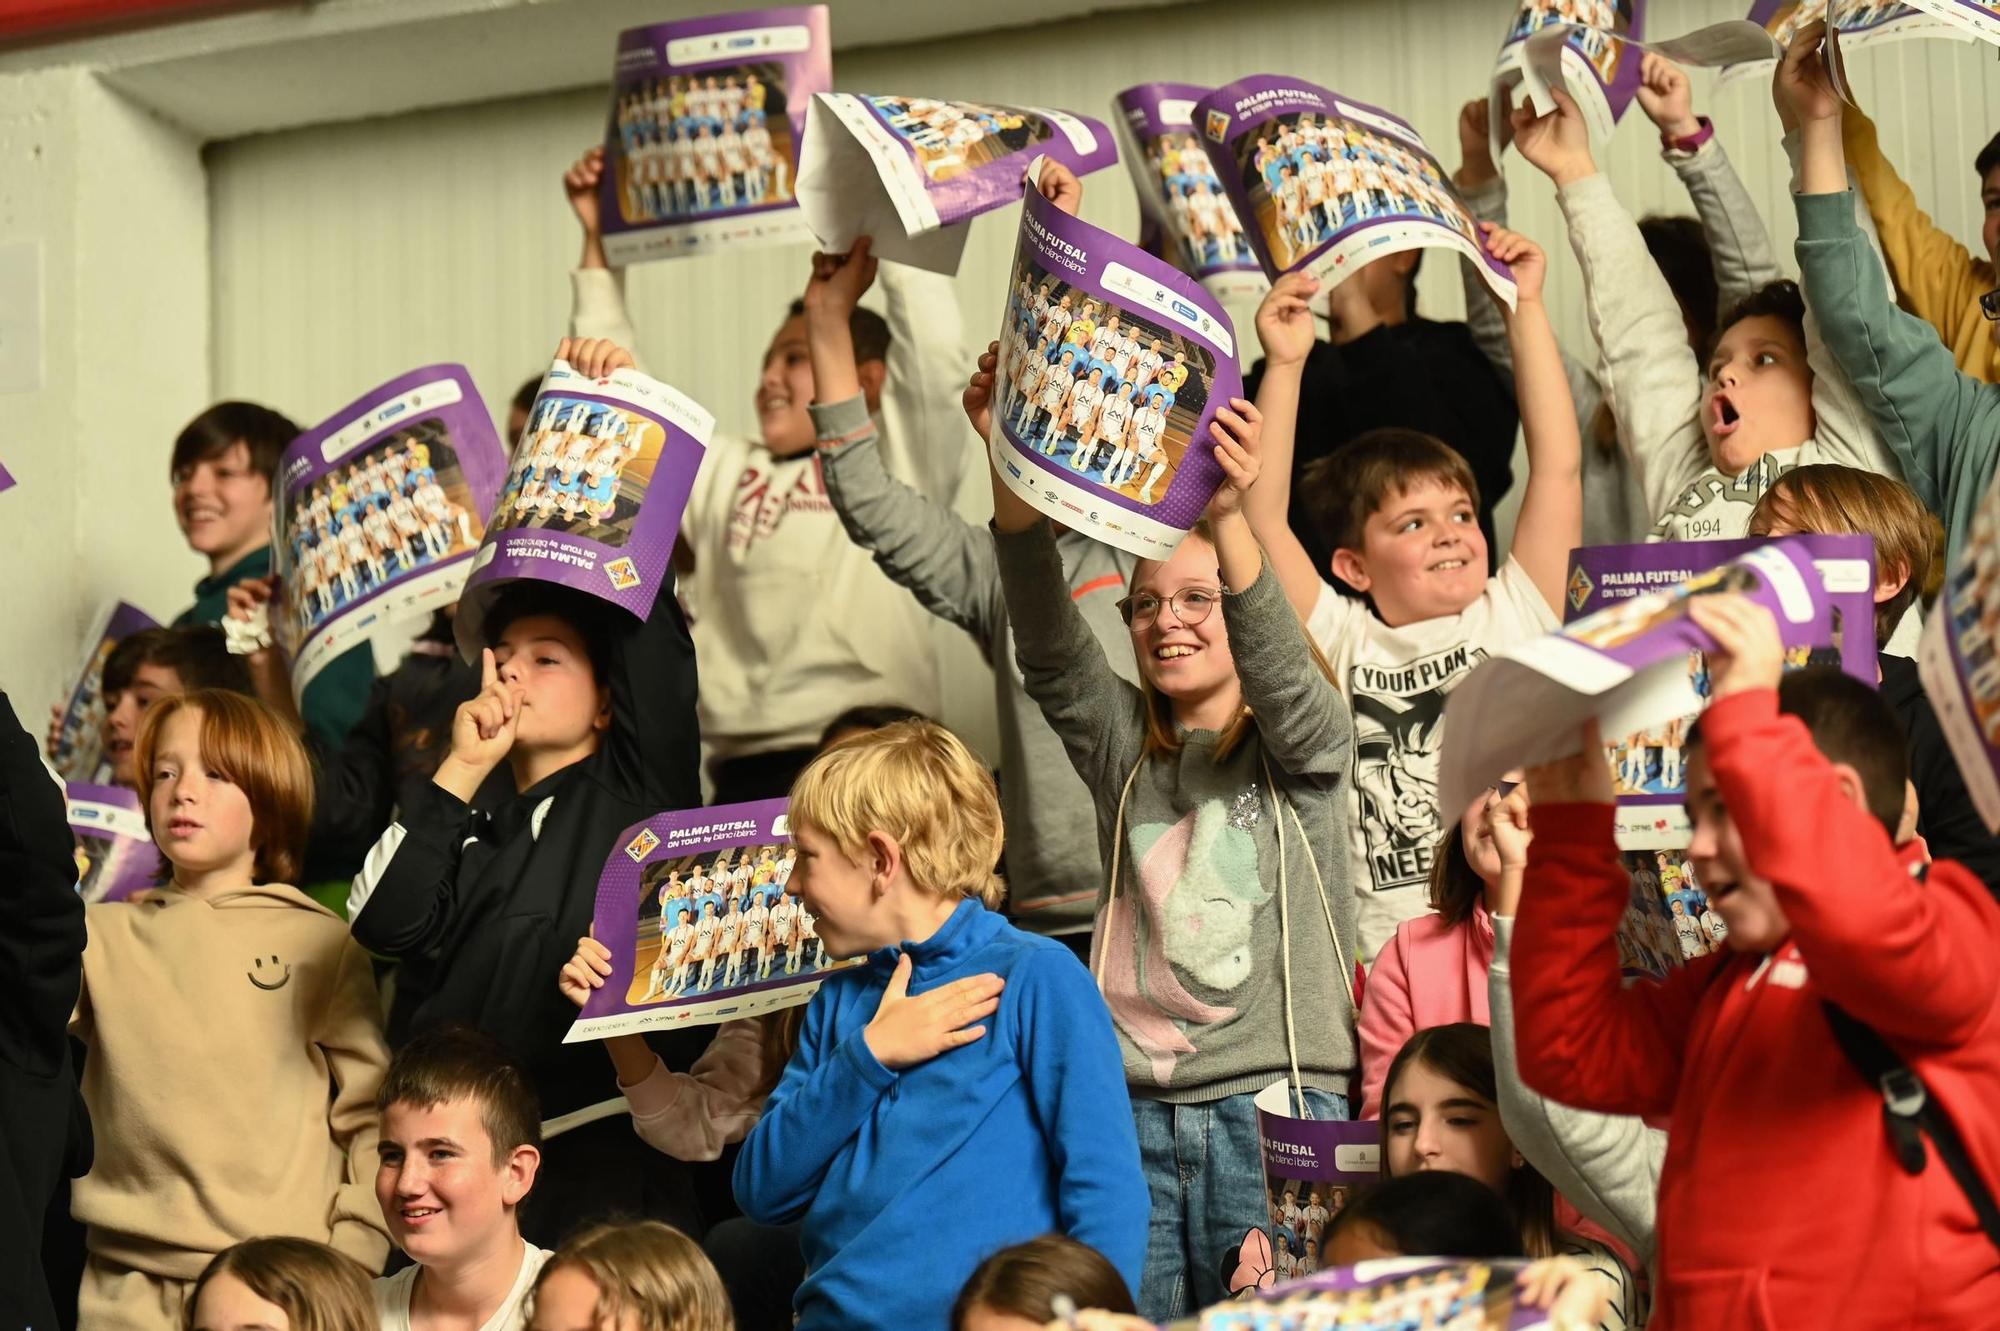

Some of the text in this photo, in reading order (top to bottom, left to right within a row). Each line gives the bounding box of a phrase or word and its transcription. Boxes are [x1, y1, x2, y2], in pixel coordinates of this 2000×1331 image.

[1235, 89, 1278, 112] PALMA
[1278, 89, 1322, 102] FUTSAL
[1025, 208, 1088, 263] PALMA FUTSAL
[1038, 242, 1045, 253] by
[1684, 518, 1721, 540] 1994
[549, 539, 558, 548] by
[560, 543, 582, 556] TOUR
[506, 547, 595, 570] PALMA FUTSAL
[582, 549, 597, 560] ON
[1601, 571, 1645, 586] PALMA
[1602, 589, 1614, 598] ON
[1615, 588, 1637, 598] TOUR
[1362, 647, 1468, 692] YOUR PLAN
[669, 820, 757, 839] PALMA FUTSAL
[667, 840, 681, 849] ON
[681, 837, 701, 847] TOUR
[1376, 847, 1432, 881] NEE
[1272, 1141, 1315, 1156] FUTSAL
